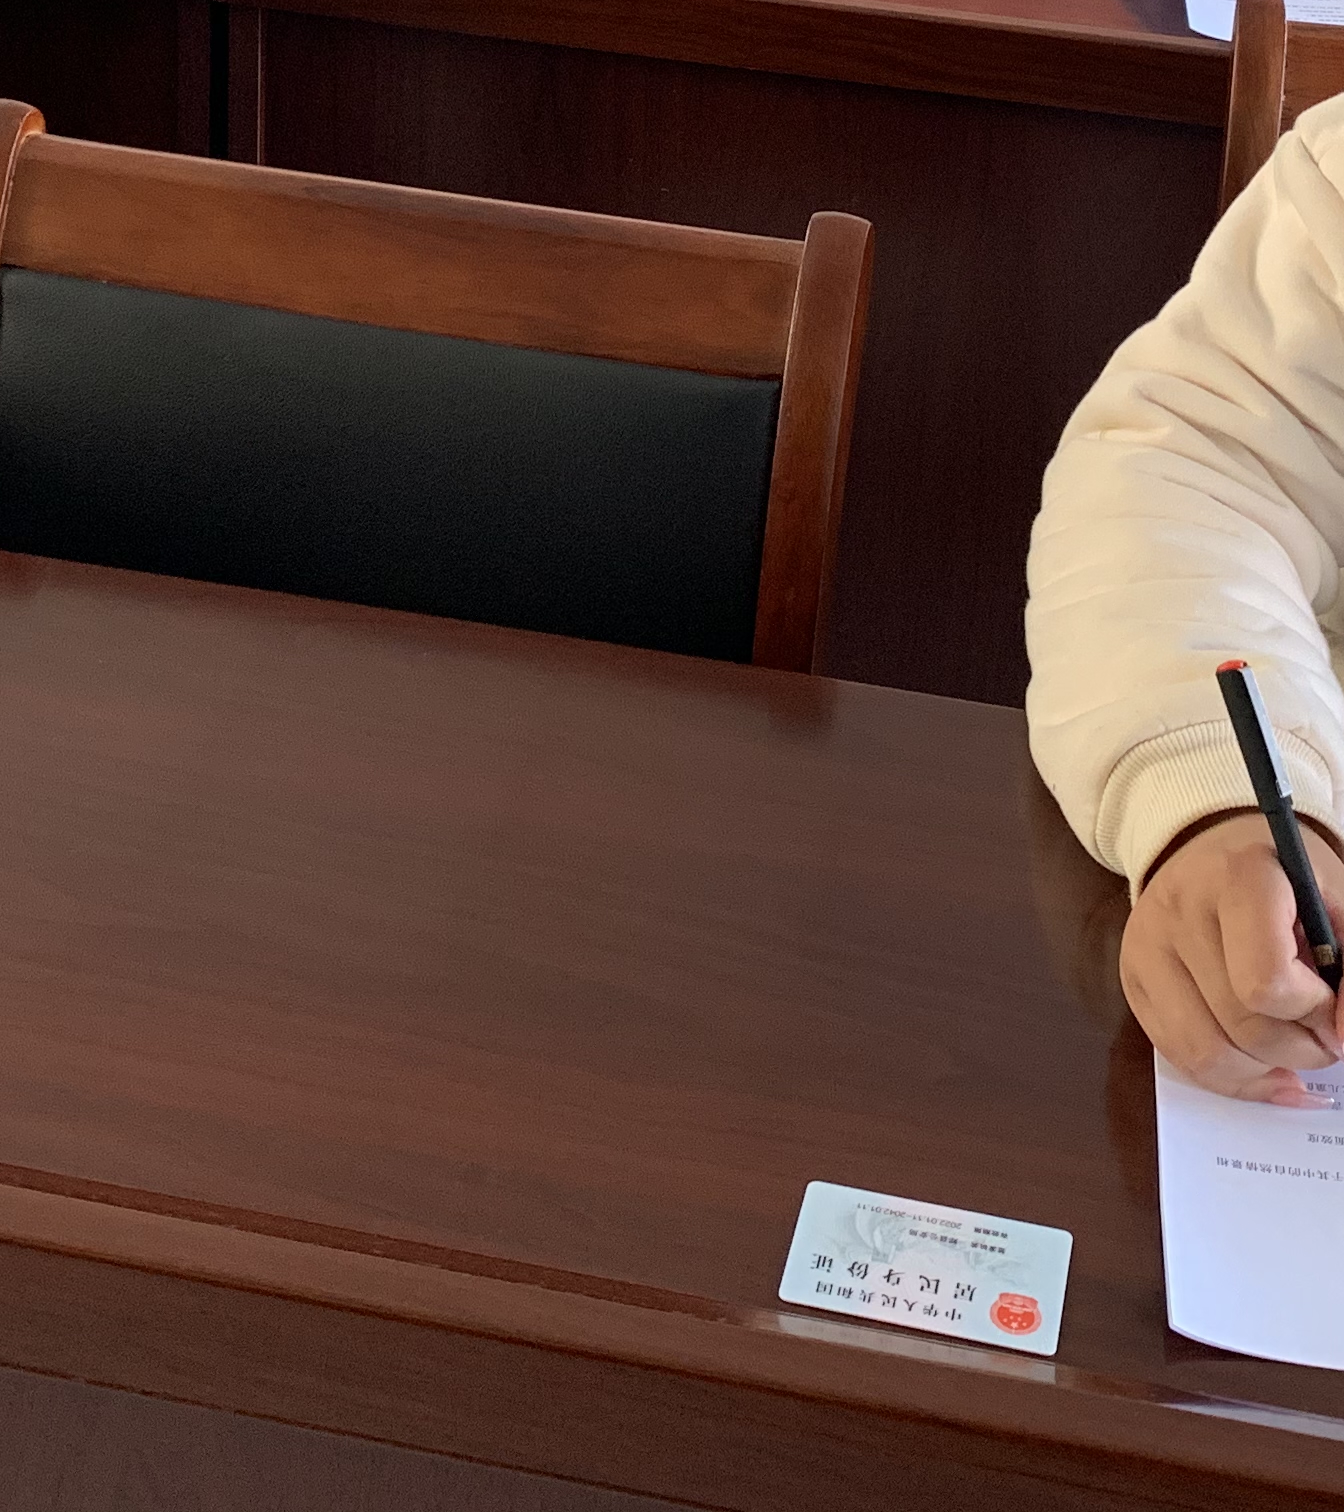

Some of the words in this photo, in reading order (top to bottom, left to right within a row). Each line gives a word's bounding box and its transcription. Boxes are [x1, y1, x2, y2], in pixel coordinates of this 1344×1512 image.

[810, 1252, 977, 1303] 居民身份证
[815, 1280, 962, 1322] 中华人民共和国
